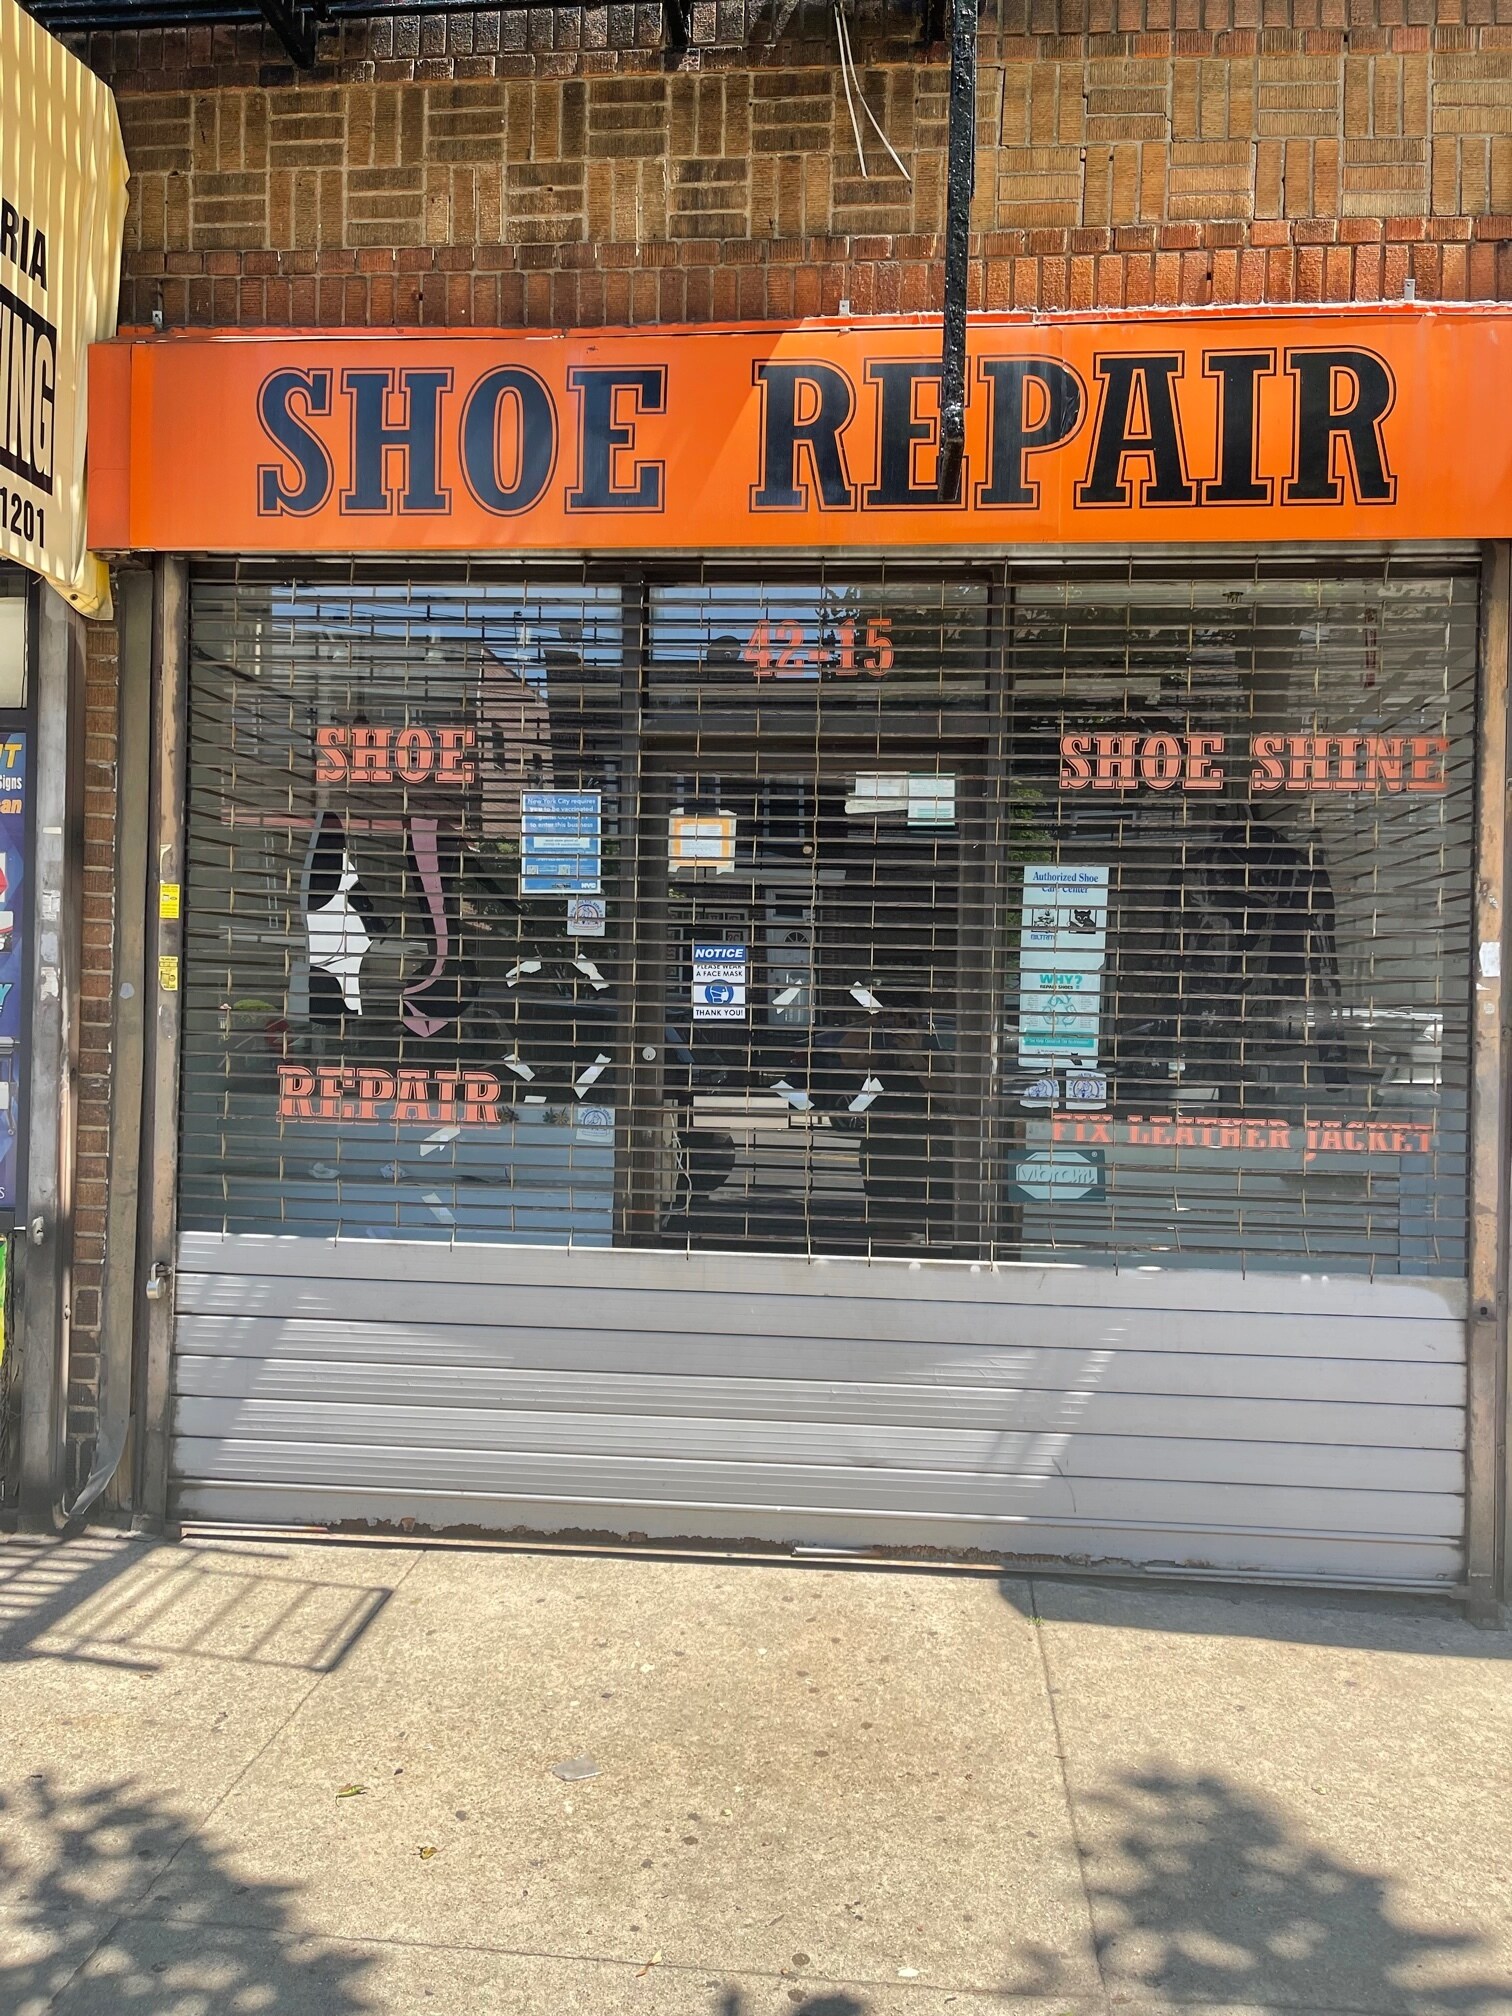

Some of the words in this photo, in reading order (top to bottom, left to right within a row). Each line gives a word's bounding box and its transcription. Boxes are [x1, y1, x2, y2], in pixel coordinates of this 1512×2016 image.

[0, 197, 48, 292] RIA
[0, 301, 53, 478] ING
[257, 363, 668, 518] SHOE
[749, 344, 1398, 513] REPAIR
[0, 486, 44, 548] 1201
[743, 618, 895, 677] 42-15
[0, 743, 22, 768] T
[316, 725, 475, 783] SHOE
[1060, 731, 1225, 791] SHOE
[1252, 732, 1450, 792] SHINE
[558, 798, 570, 806] City
[571, 798, 595, 806] requires
[1033, 871, 1077, 882] Authorized
[1078, 873, 1099, 883] Shoe
[695, 948, 744, 959] NOTICE
[1039, 974, 1083, 989] WHY?
[724, 1009, 744, 1017] YOU!
[276, 1065, 502, 1130] REPAIR
[1052, 1113, 1114, 1144] FIX
[1127, 1115, 1292, 1150] LEATHER
[1305, 1119, 1435, 1162] JACKET
